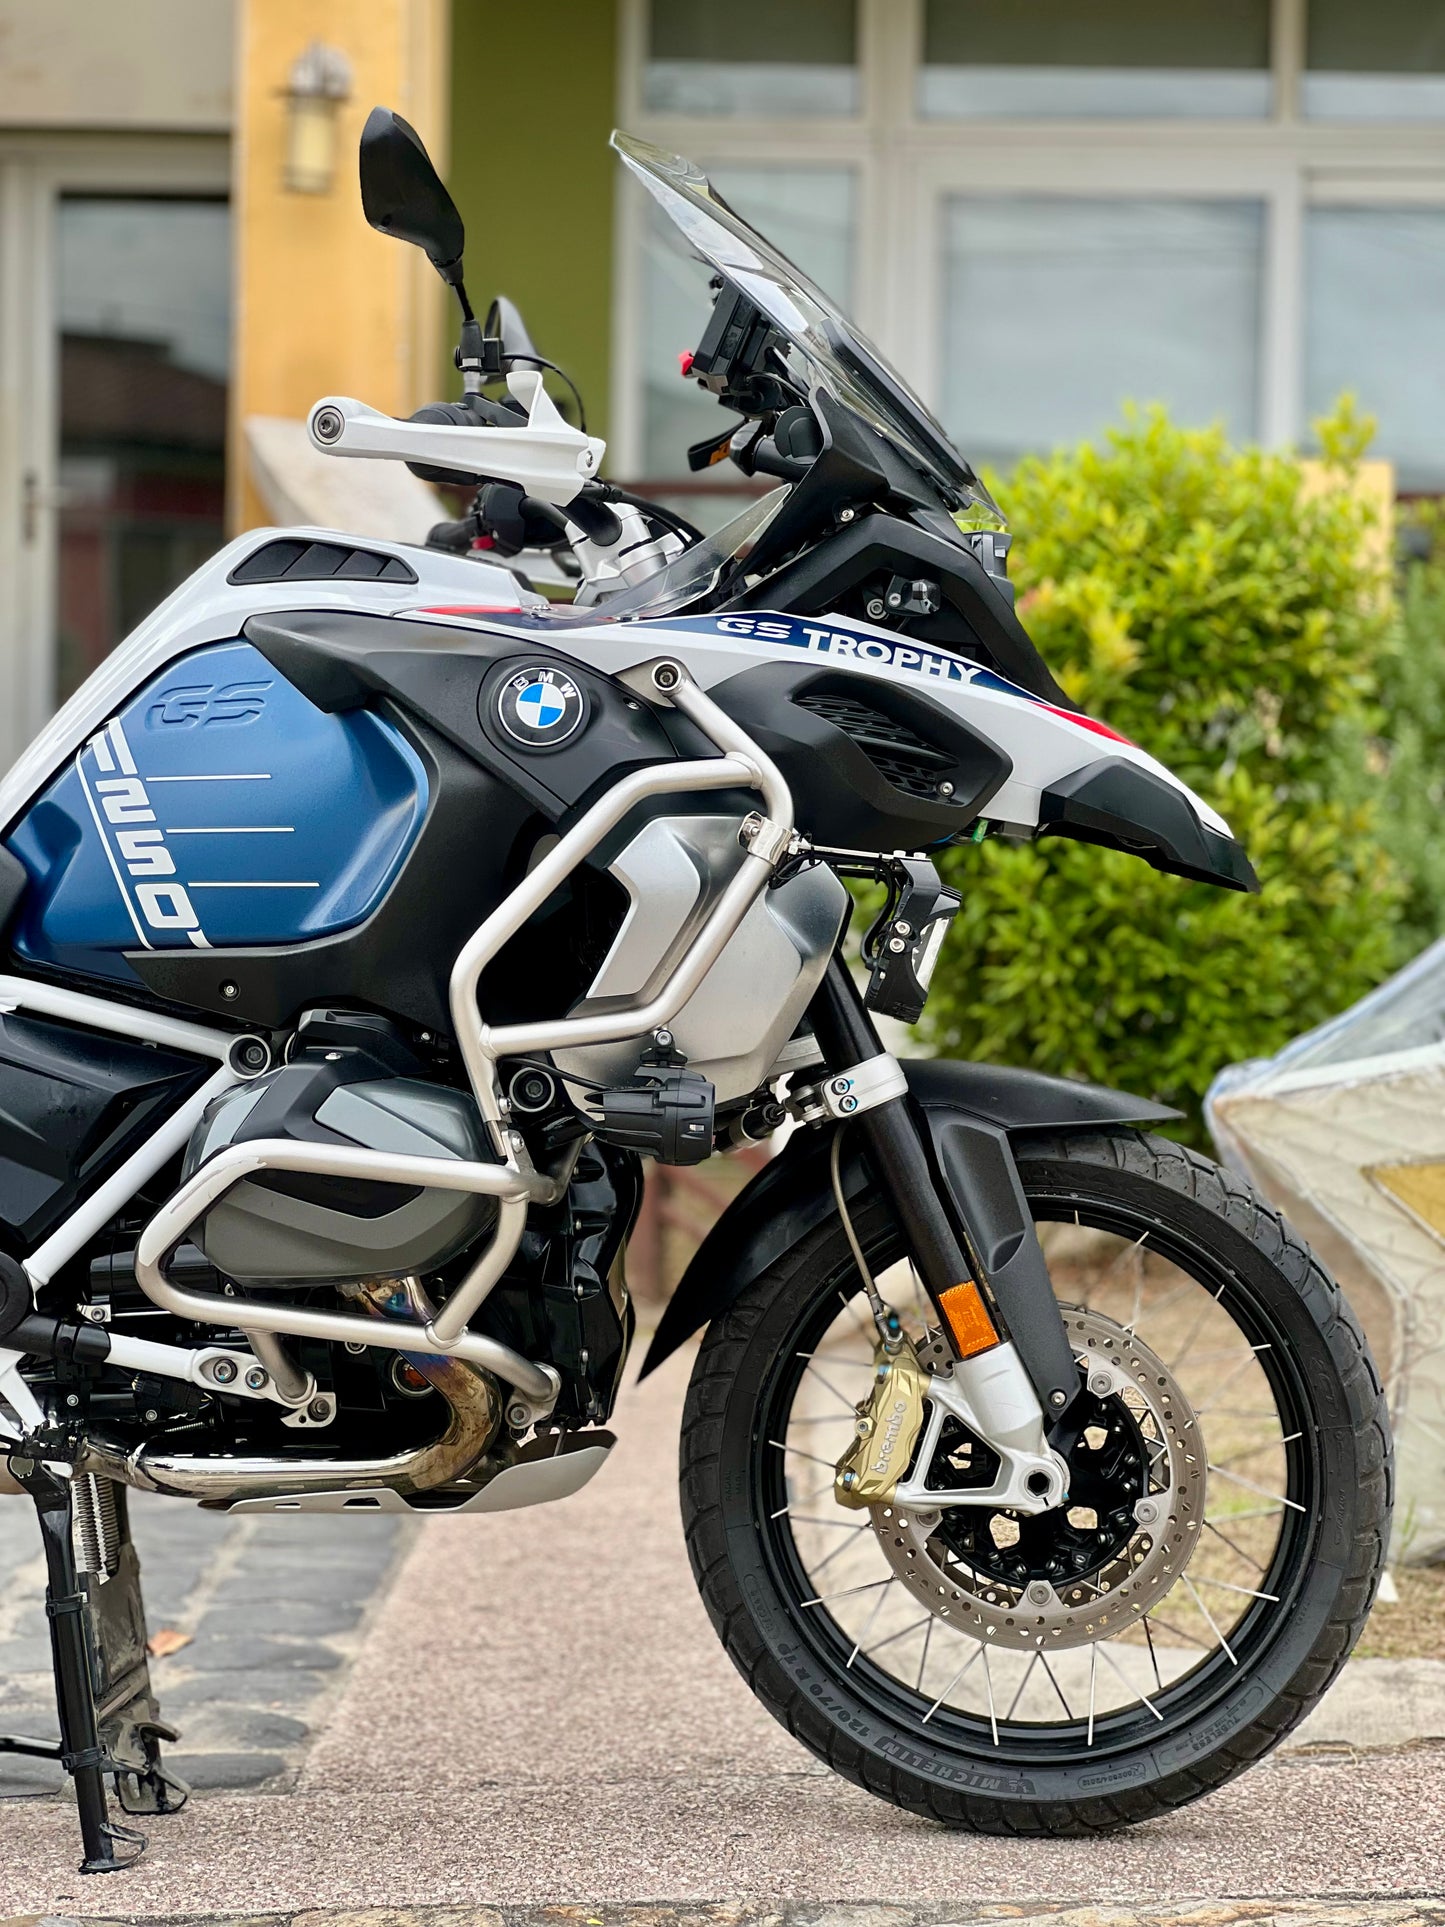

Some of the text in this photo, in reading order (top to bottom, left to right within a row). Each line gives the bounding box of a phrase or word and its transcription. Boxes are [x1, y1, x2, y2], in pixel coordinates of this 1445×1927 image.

[716, 617, 982, 685] GS TROPHY
[145, 680, 274, 730] GS
[512, 671, 577, 699] BMW
[871, 1400, 907, 1474] brembo
[795, 1663, 812, 1681] R
[809, 1683, 870, 1737] 120/70
[1192, 1717, 1241, 1751] TUBELESS
[882, 1741, 1001, 1790] MICHELIN
